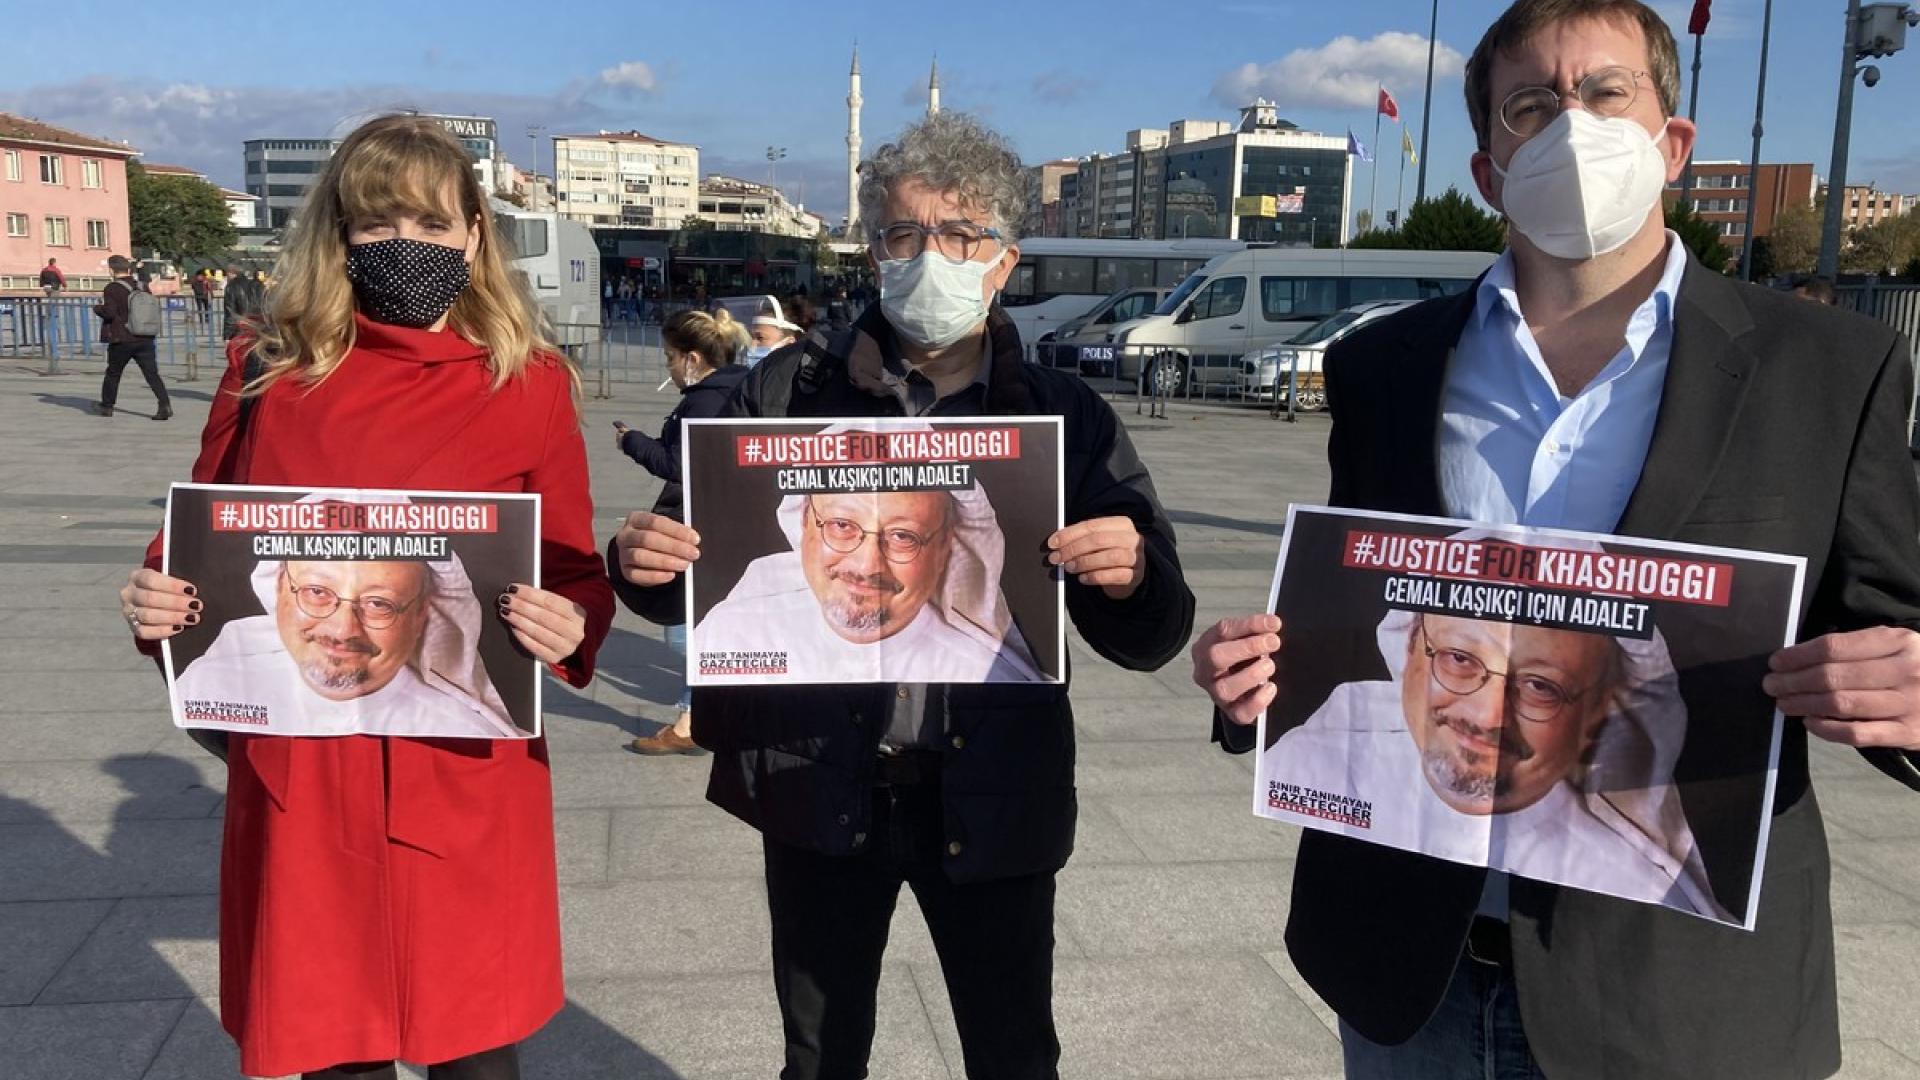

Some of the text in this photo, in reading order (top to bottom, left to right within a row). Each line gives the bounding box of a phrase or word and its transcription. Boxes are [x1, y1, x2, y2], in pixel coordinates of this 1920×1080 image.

[1083, 347, 1113, 360] POLIS
[745, 431, 1010, 463] #JUSTICEFORKHASHOGGI
[777, 469, 826, 490] CEMAL
[917, 465, 970, 487] ADALET
[219, 503, 488, 530] #JUSTICEFORKHASHOGGI
[253, 535, 301, 556] CEMAL
[394, 536, 447, 557] ADALET
[1352, 534, 1716, 601] #JUSTICEFORKHASHOGGI
[1385, 577, 1444, 608] CEMAL
[1570, 597, 1649, 632] ADALET
[1269, 780, 1371, 810] SINIR TANIMAYAN
